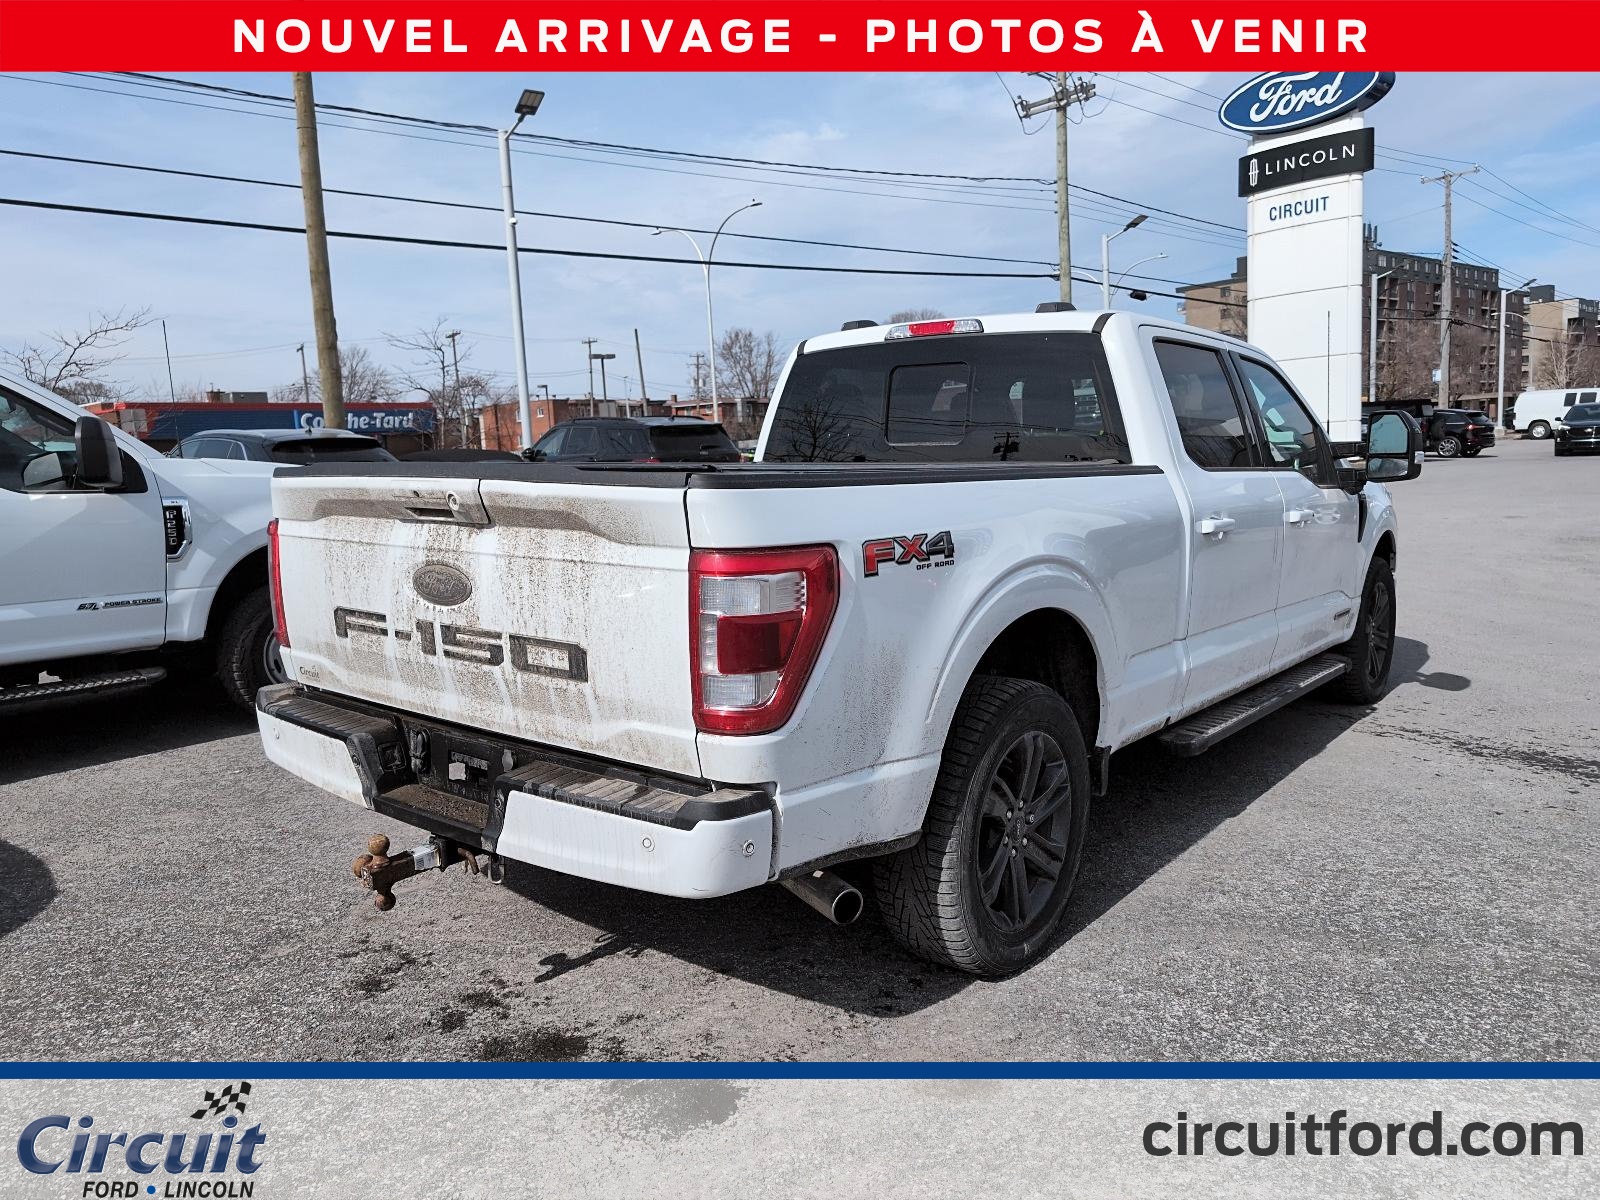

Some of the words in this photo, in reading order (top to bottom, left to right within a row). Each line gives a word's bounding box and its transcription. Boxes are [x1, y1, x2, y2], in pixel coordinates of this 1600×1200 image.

[1249, 72, 1345, 122] Ford
[1265, 144, 1355, 175] LINCOLN
[1269, 196, 1330, 221] CIRCUIT
[300, 412, 414, 429] Cohe-Tard
[862, 530, 955, 578] FX4
[916, 562, 932, 571] OFF
[934, 559, 955, 568] ROAD
[132, 597, 162, 605] STROKE
[333, 605, 589, 684] F-150
